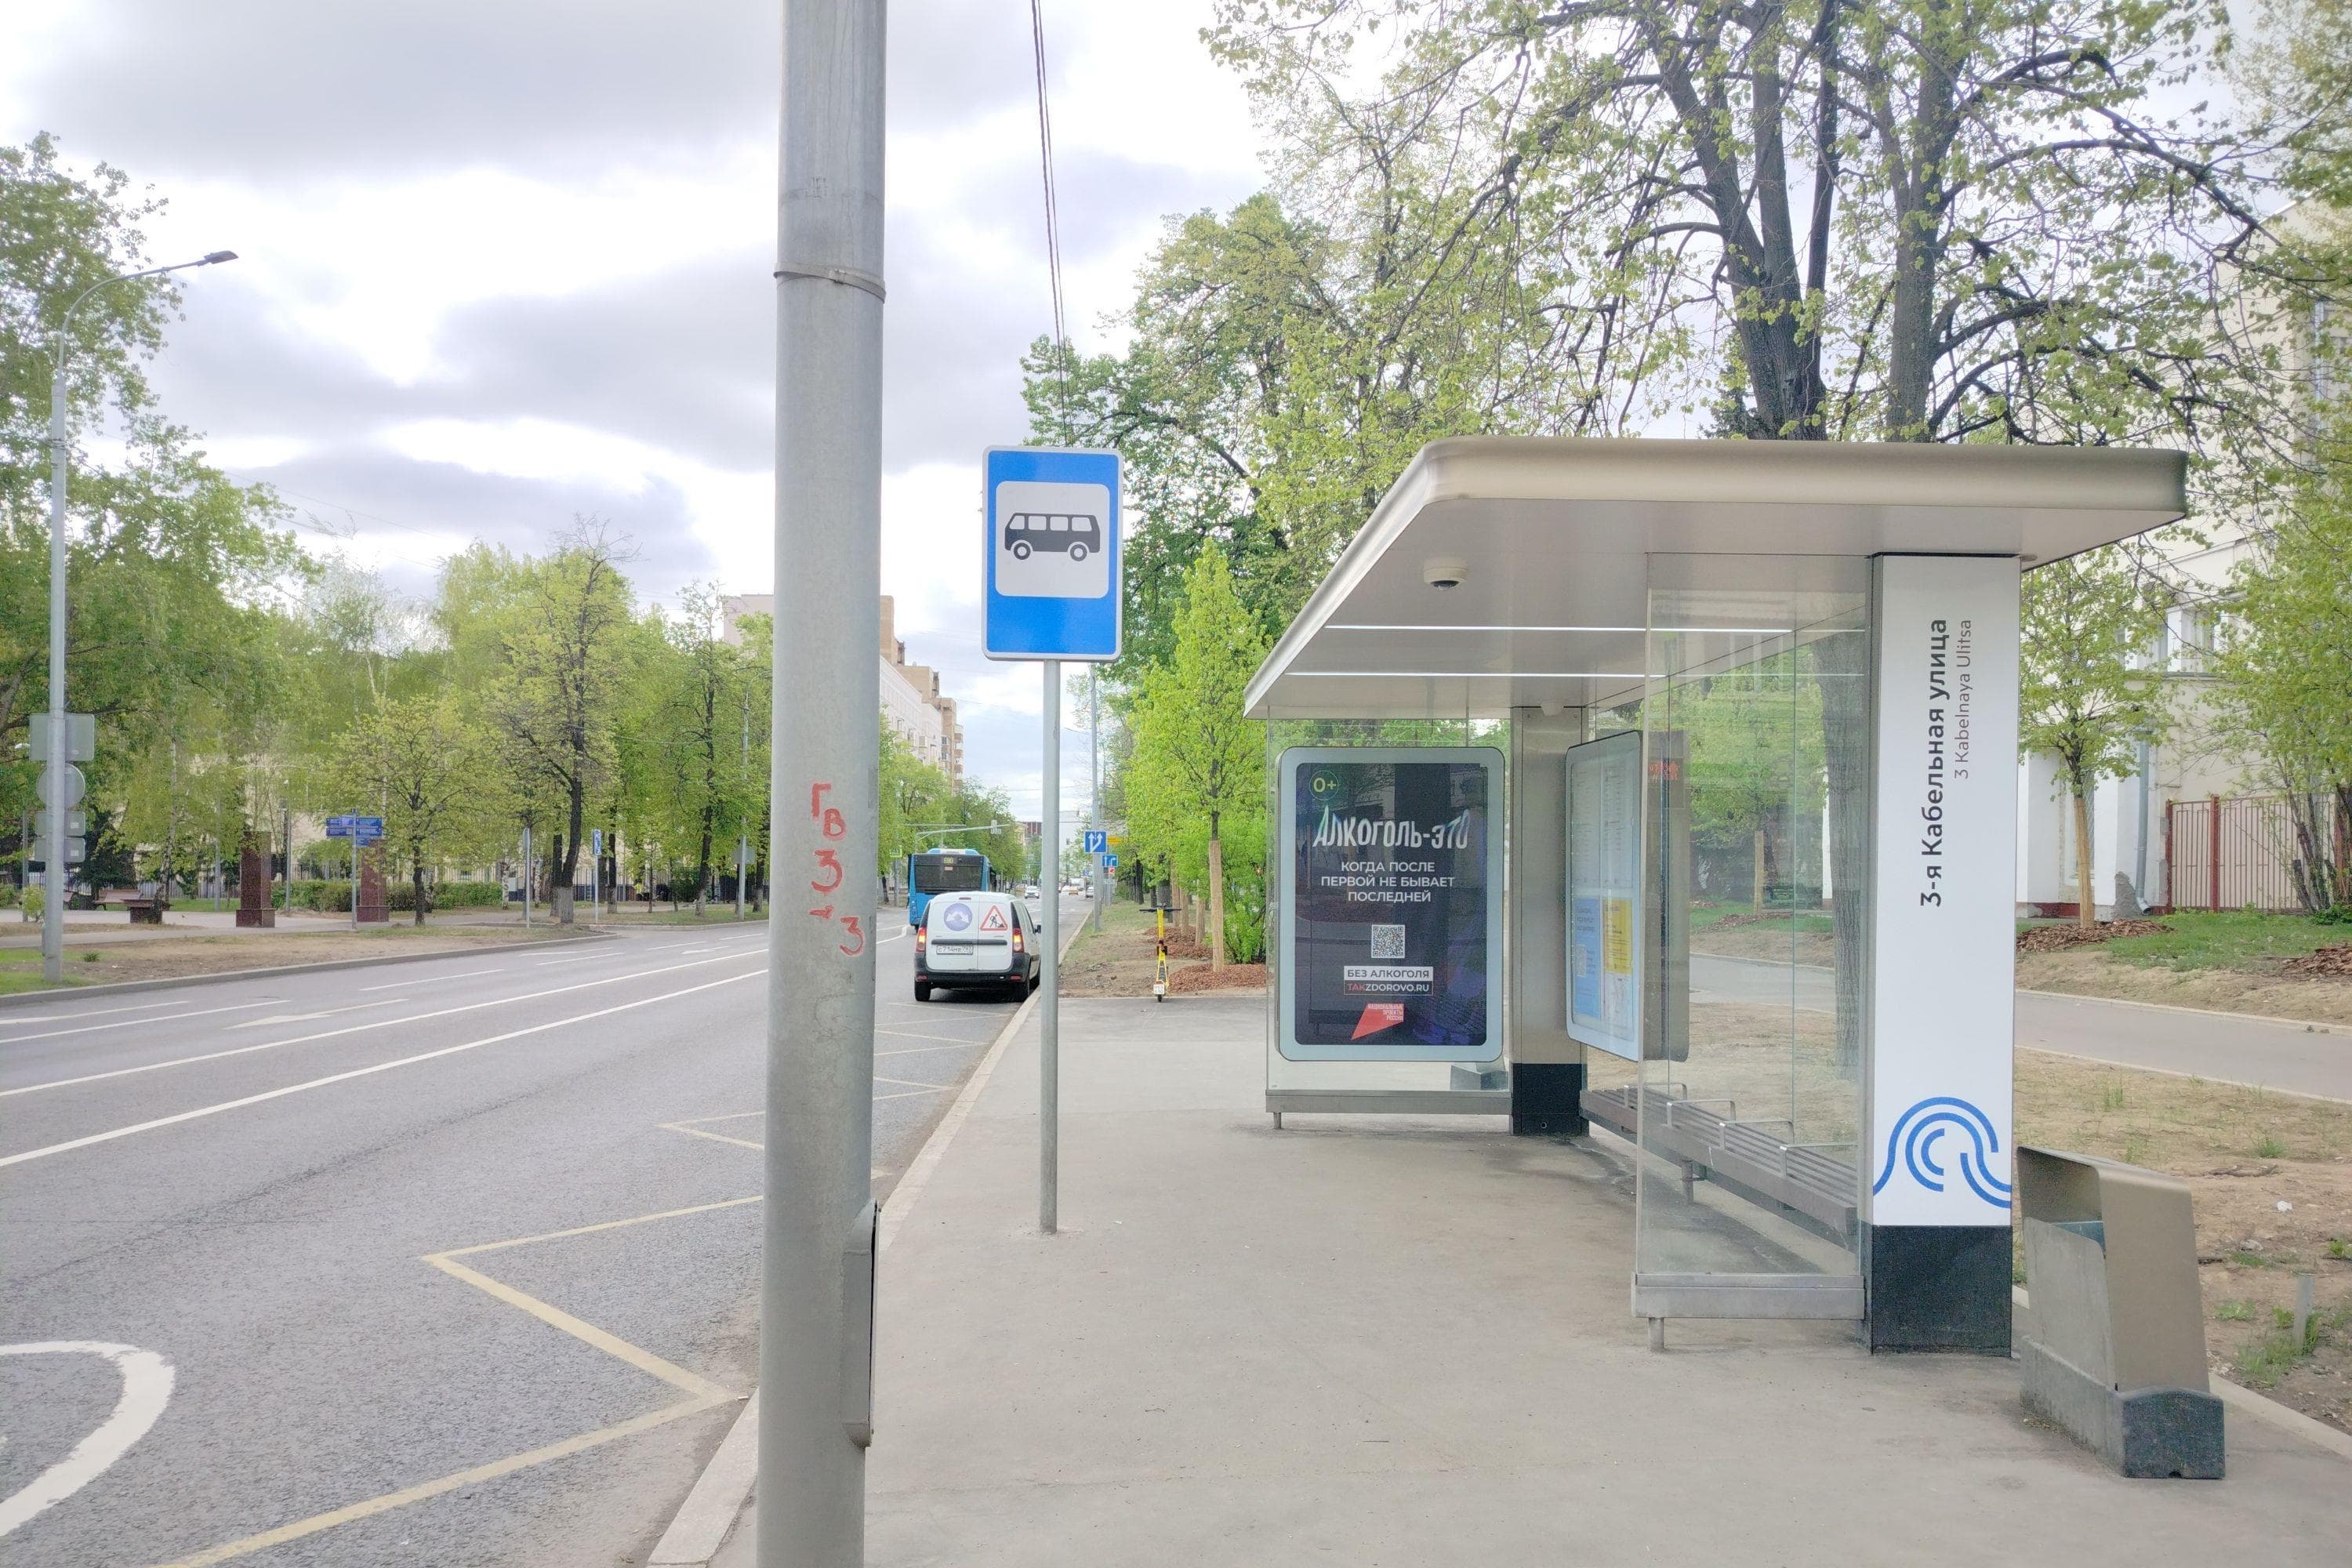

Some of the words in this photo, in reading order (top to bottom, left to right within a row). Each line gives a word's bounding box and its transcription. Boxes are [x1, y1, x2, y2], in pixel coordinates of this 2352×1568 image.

[1955, 619, 1972, 668] Ulitsa
[1929, 619, 1951, 701] улица
[1954, 673, 1973, 763] Kabelnaya
[1920, 708, 1945, 856] Кабельная
[1954, 769, 1969, 780] 3
[1313, 777, 1337, 793] 0+
[1341, 862, 1385, 874] КОГДА
[1389, 862, 1436, 873] ПОСЛЕ
[1321, 874, 1375, 887] ПЕРВОЙ
[1379, 877, 1397, 887] НЕ
[1400, 877, 1455, 887] БЫВАЕТ
[1920, 866, 1942, 908] 3-я
[1348, 890, 1432, 904] ПОСЛЕДНЕЙ
[1347, 969, 1367, 978] БЕЗ
[1370, 970, 1429, 978] АЛКОГОЛЯ
